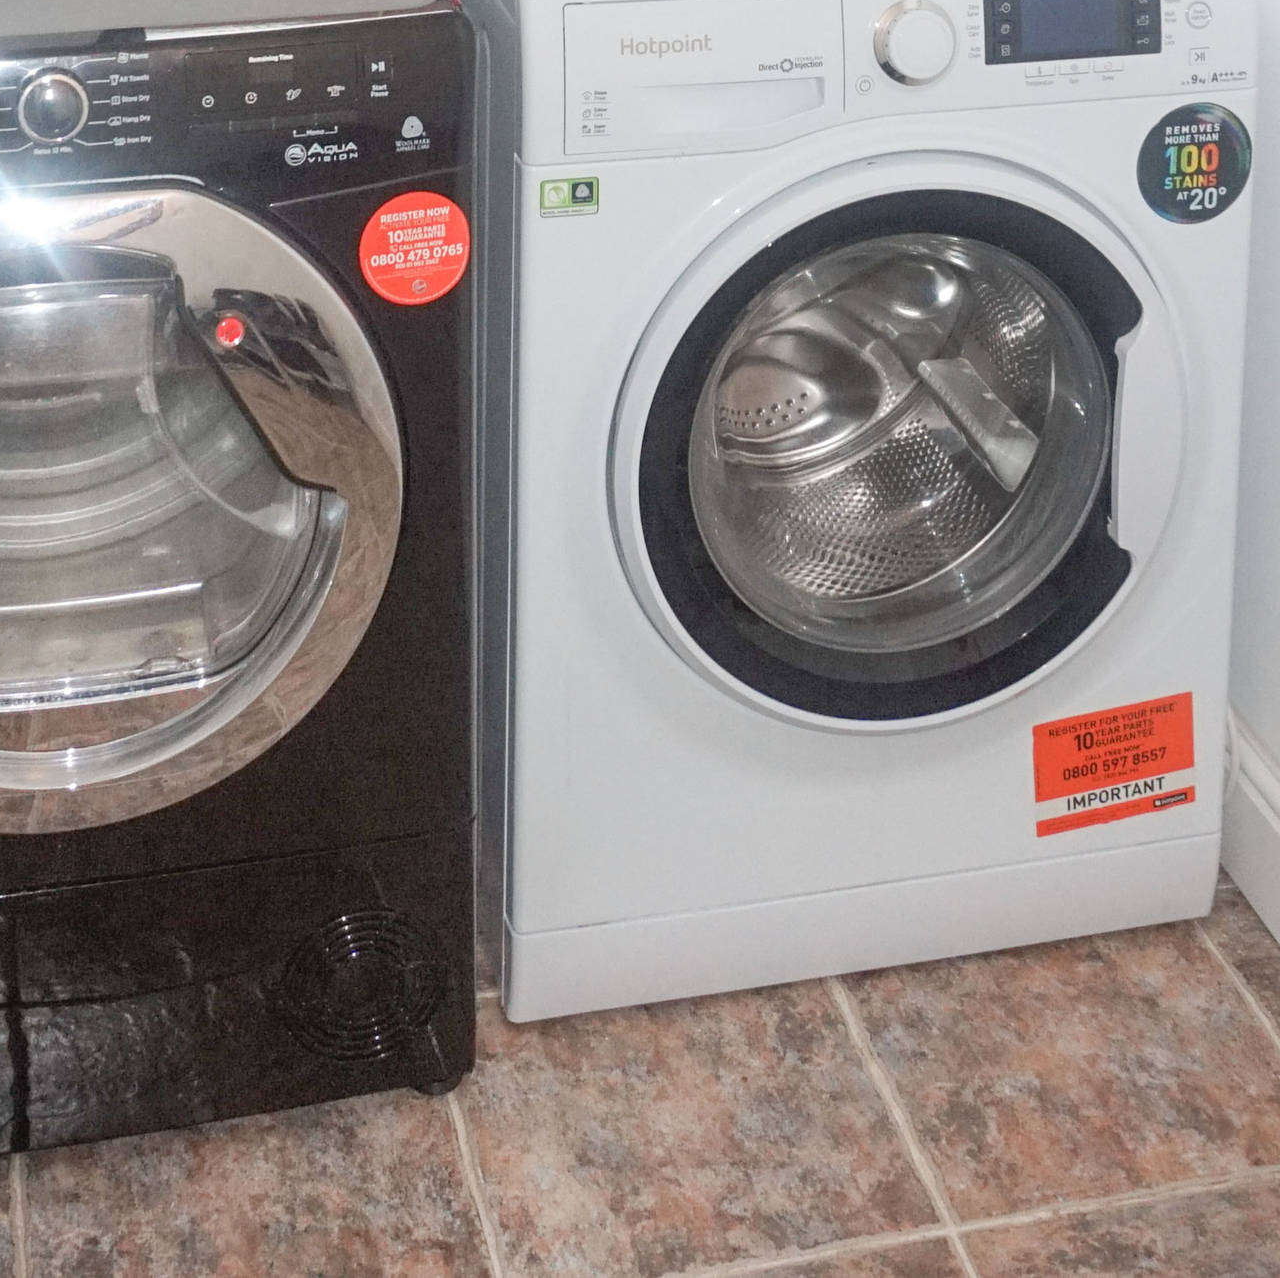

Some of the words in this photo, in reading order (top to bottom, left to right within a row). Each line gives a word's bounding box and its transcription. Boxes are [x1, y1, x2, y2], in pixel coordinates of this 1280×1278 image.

[620, 34, 712, 58] Hotpoint
[758, 63, 779, 71] Direct
[1166, 123, 1220, 135] REMOVES
[1164, 135, 1192, 145] MORE
[1192, 132, 1219, 143] THAN
[307, 152, 358, 163] VISION
[308, 142, 358, 156] AQUA
[1165, 142, 1220, 174] 100
[1164, 173, 1217, 190] STAINS
[1176, 191, 1190, 201] AT
[380, 210, 425, 223] REGISTER
[426, 206, 450, 217] NOW
[387, 230, 404, 244] 10
[370, 252, 404, 267] 0800
[407, 248, 430, 261] 479
[433, 243, 463, 257] 0765
[1048, 720, 1097, 738] REGISTER
[1099, 715, 1119, 727] FOR
[1120, 708, 1148, 722] YOUR
[1095, 725, 1121, 737] YEAR
[1123, 719, 1155, 731] PARTS
[1074, 731, 1095, 752] 10
[1095, 728, 1155, 748] GUARANTEE
[1063, 762, 1098, 781] 0800
[1102, 755, 1128, 773] 597
[1132, 747, 1167, 765] 8557
[1067, 776, 1166, 812] IMPORTANT
